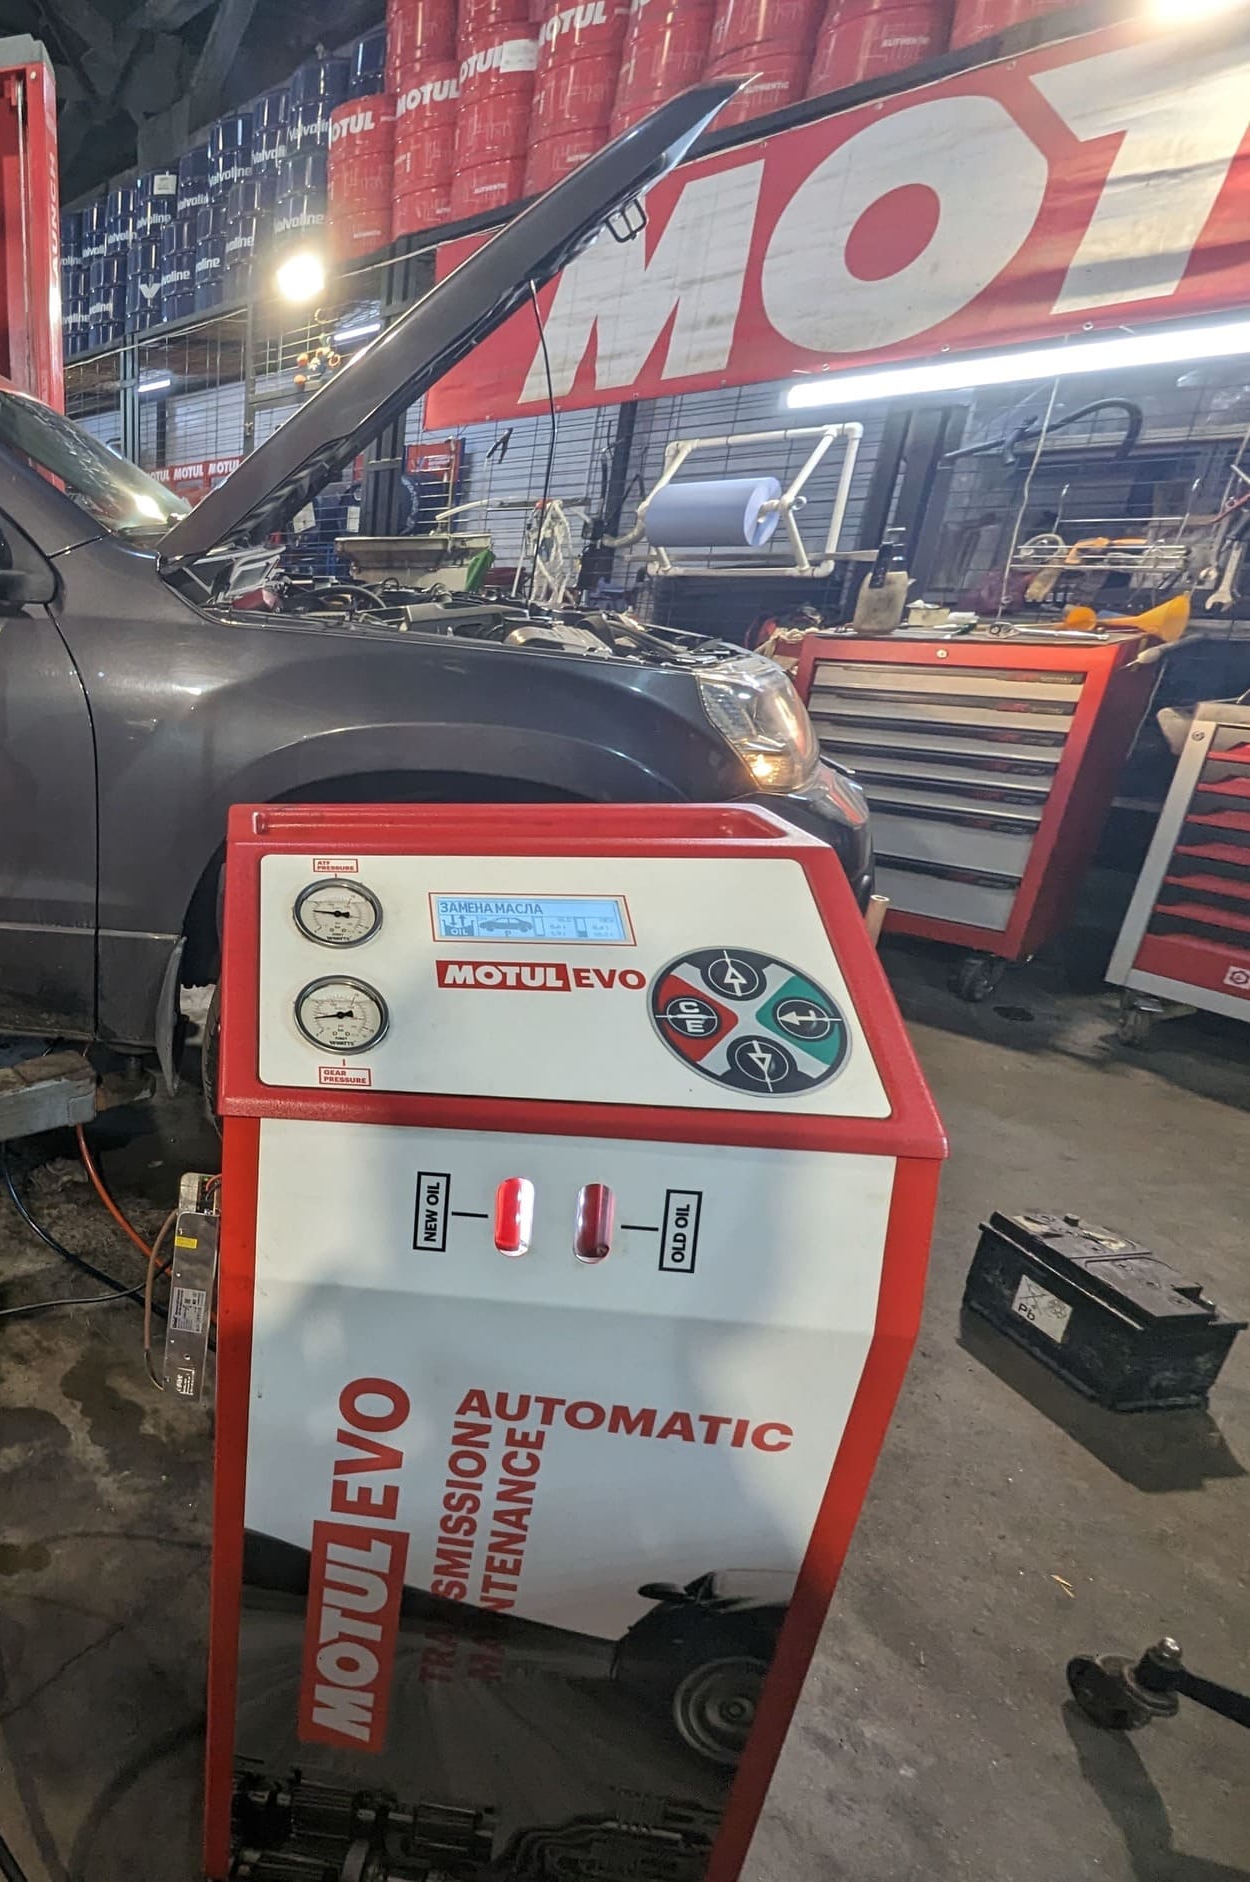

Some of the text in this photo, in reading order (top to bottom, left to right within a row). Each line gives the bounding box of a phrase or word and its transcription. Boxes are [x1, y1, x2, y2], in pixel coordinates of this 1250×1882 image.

[174, 463, 204, 481] MOTUL
[440, 902, 544, 915] ЗАМЕНА МАСЛА
[451, 928, 469, 936] OIL
[444, 964, 647, 990] MOTUL EVO
[323, 1076, 367, 1084] PRESSURE
[423, 1182, 440, 1242] NEW OIL
[671, 1204, 690, 1263] OLD OIL
[1018, 1303, 1036, 1321] Pb
[455, 1389, 794, 1452] AUTOMATIC
[312, 1377, 410, 1743] MOTUL EVO
[419, 1420, 492, 1683] TRASMISSION
[467, 1427, 546, 1682] MANTENANCE
